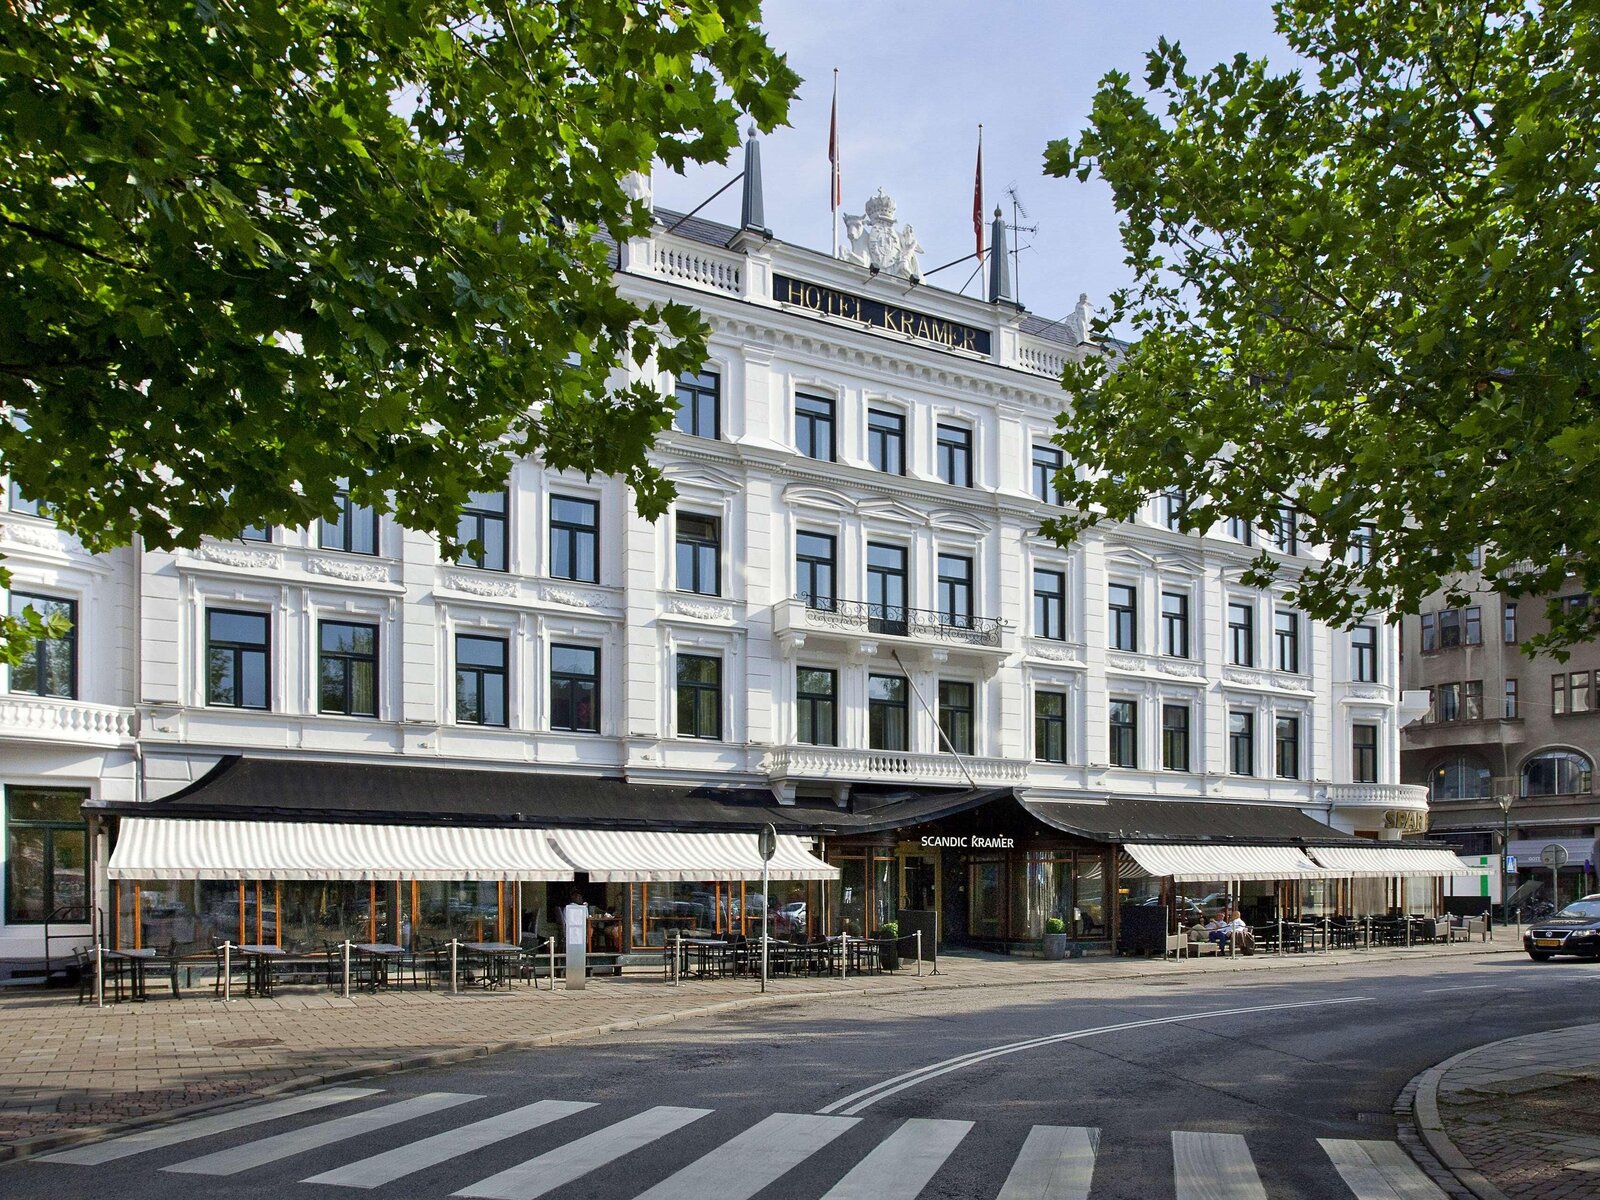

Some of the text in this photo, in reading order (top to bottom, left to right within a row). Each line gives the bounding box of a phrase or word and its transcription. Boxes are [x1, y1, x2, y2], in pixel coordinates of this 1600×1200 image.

[788, 280, 976, 351] HOTEL KRAMER
[921, 836, 1014, 848] SCANDIC KRAMER
